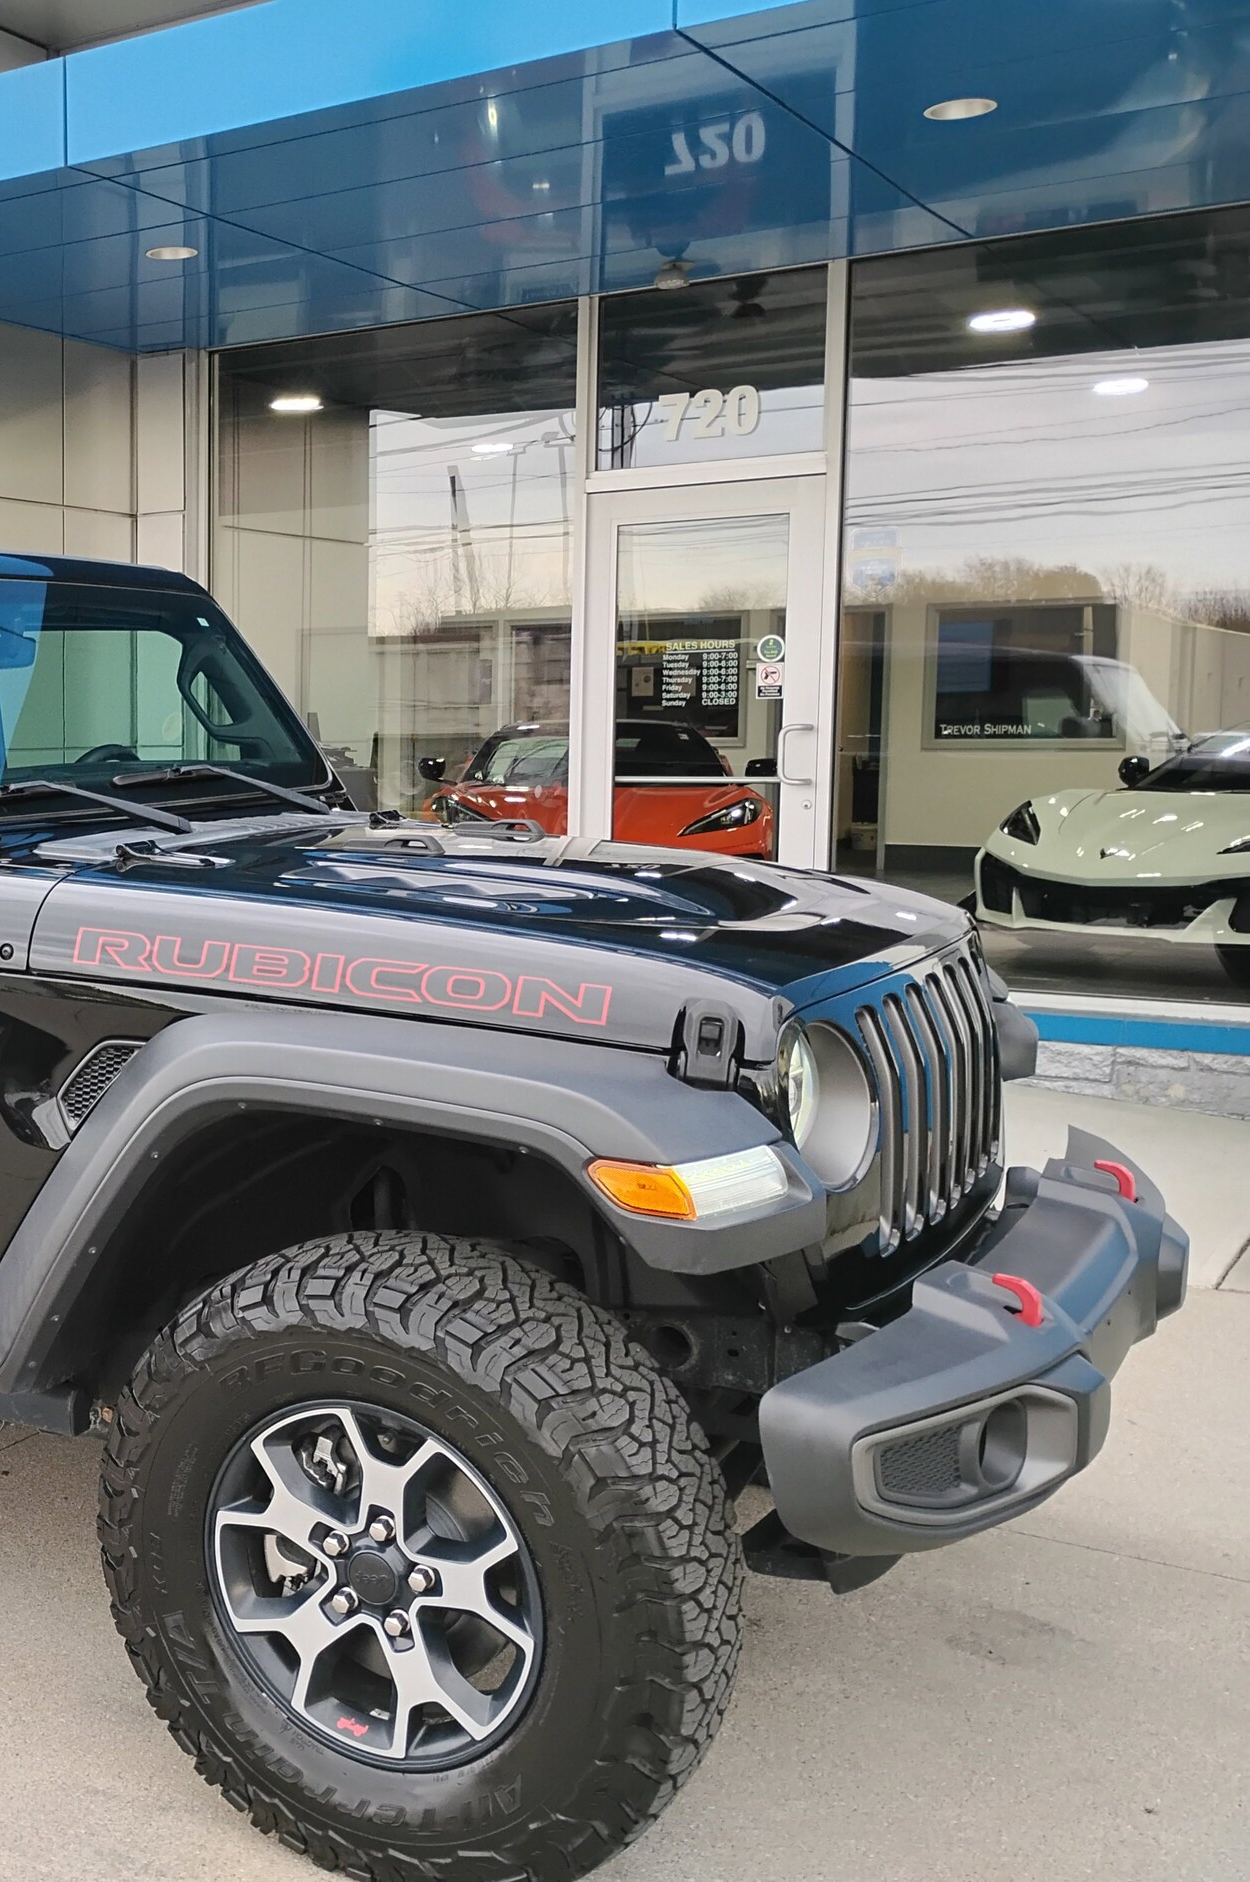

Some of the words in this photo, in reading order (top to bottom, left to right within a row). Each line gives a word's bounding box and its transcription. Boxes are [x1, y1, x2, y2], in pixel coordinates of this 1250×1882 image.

[658, 385, 761, 442] 720
[666, 641, 698, 651] SALES
[700, 640, 736, 649] HOURS
[662, 653, 690, 661] Monday
[702, 652, 739, 660] 9:00-7:00
[662, 661, 690, 669] Tuesday
[662, 668, 701, 677] Wednesday
[662, 677, 693, 685] Thursday
[662, 684, 683, 692] Friday
[661, 692, 691, 700] Saturday
[661, 699, 687, 708] Sunday
[701, 698, 736, 706] CLOSED
[939, 724, 981, 735] TREVOR
[984, 723, 1032, 735] SHIPMAN
[73, 926, 613, 1026] RUBICON
[218, 1349, 556, 1527] BFGoodrich
